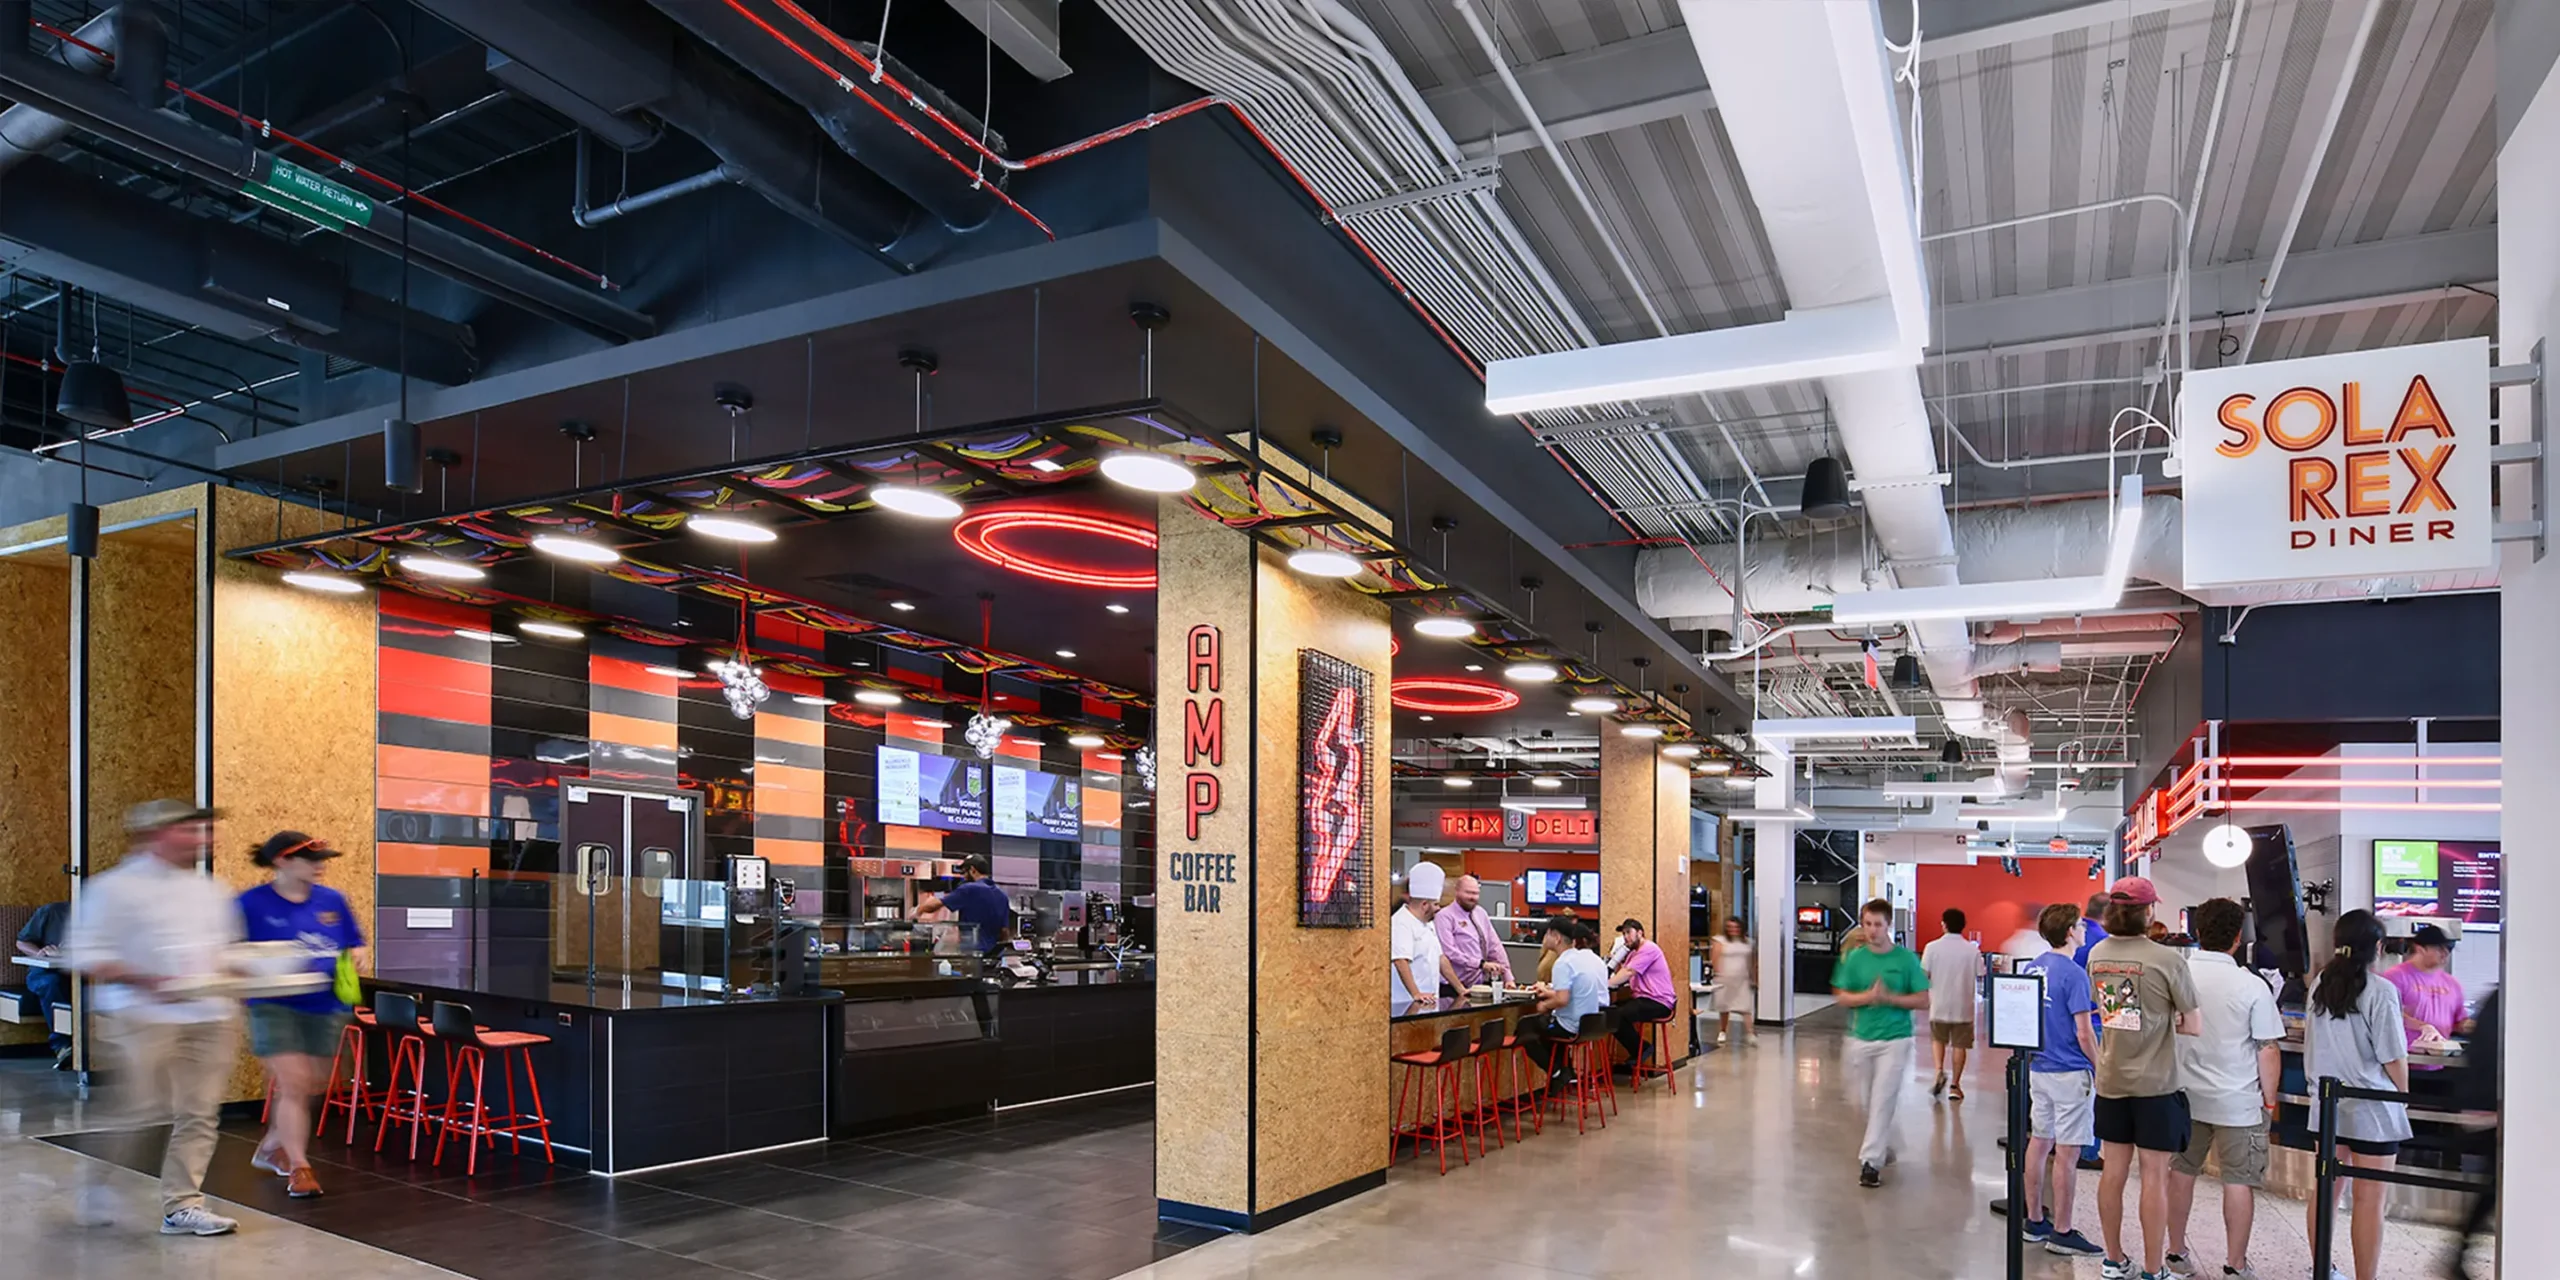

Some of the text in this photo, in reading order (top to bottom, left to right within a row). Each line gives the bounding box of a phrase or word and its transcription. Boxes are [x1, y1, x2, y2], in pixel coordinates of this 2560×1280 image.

[275, 165, 353, 207] HOT WATER RETURN
[2215, 374, 2455, 458] SOLA
[2289, 443, 2457, 522] REX
[2291, 520, 2455, 549] DINER
[1184, 624, 1222, 841] AMP
[961, 808, 982, 817] PLACE
[1442, 816, 1590, 836] TRAX DELI
[1170, 852, 1236, 883] COFFEE
[1184, 884, 1221, 913] BAR
